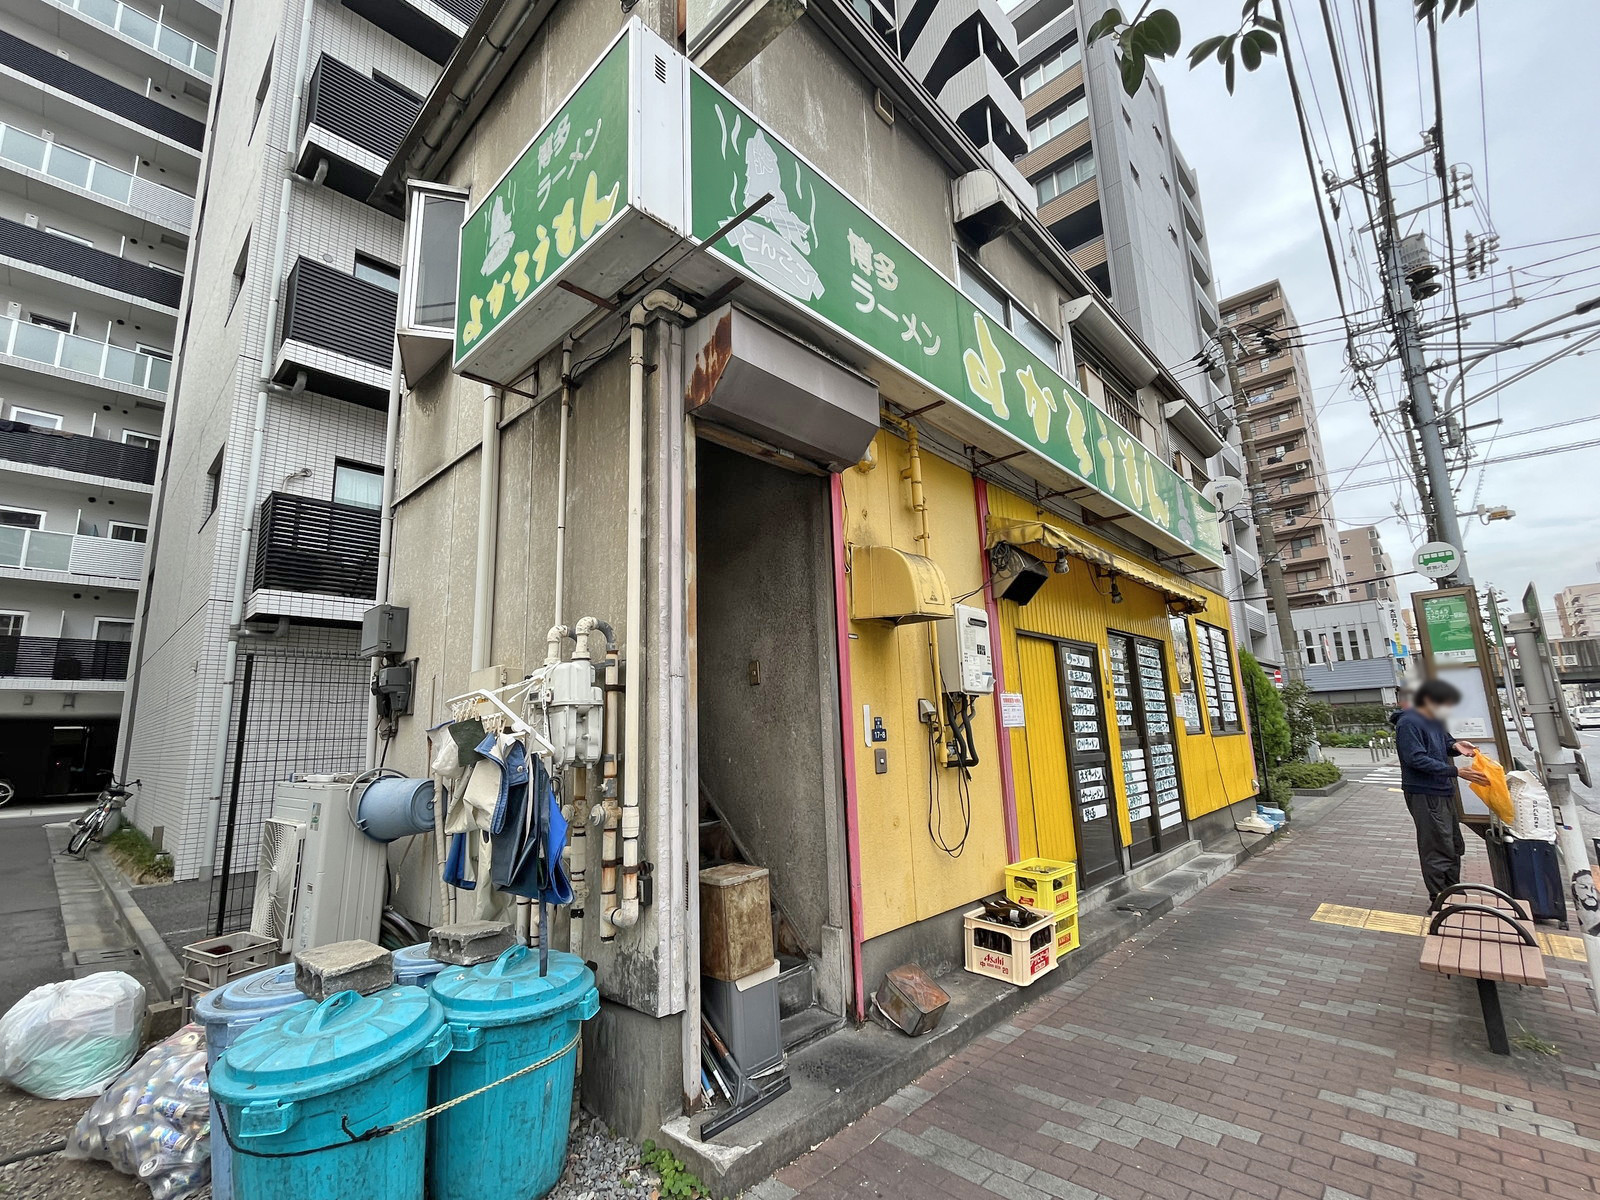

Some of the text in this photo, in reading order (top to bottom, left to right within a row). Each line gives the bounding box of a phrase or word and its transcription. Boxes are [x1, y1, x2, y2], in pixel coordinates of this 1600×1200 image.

[537, 118, 602, 212] ラーメン
[742, 226, 810, 286] とんこつ
[847, 228, 899, 292] 博多
[850, 272, 942, 356] ラーメン
[983, 953, 1005, 966] Asahi
